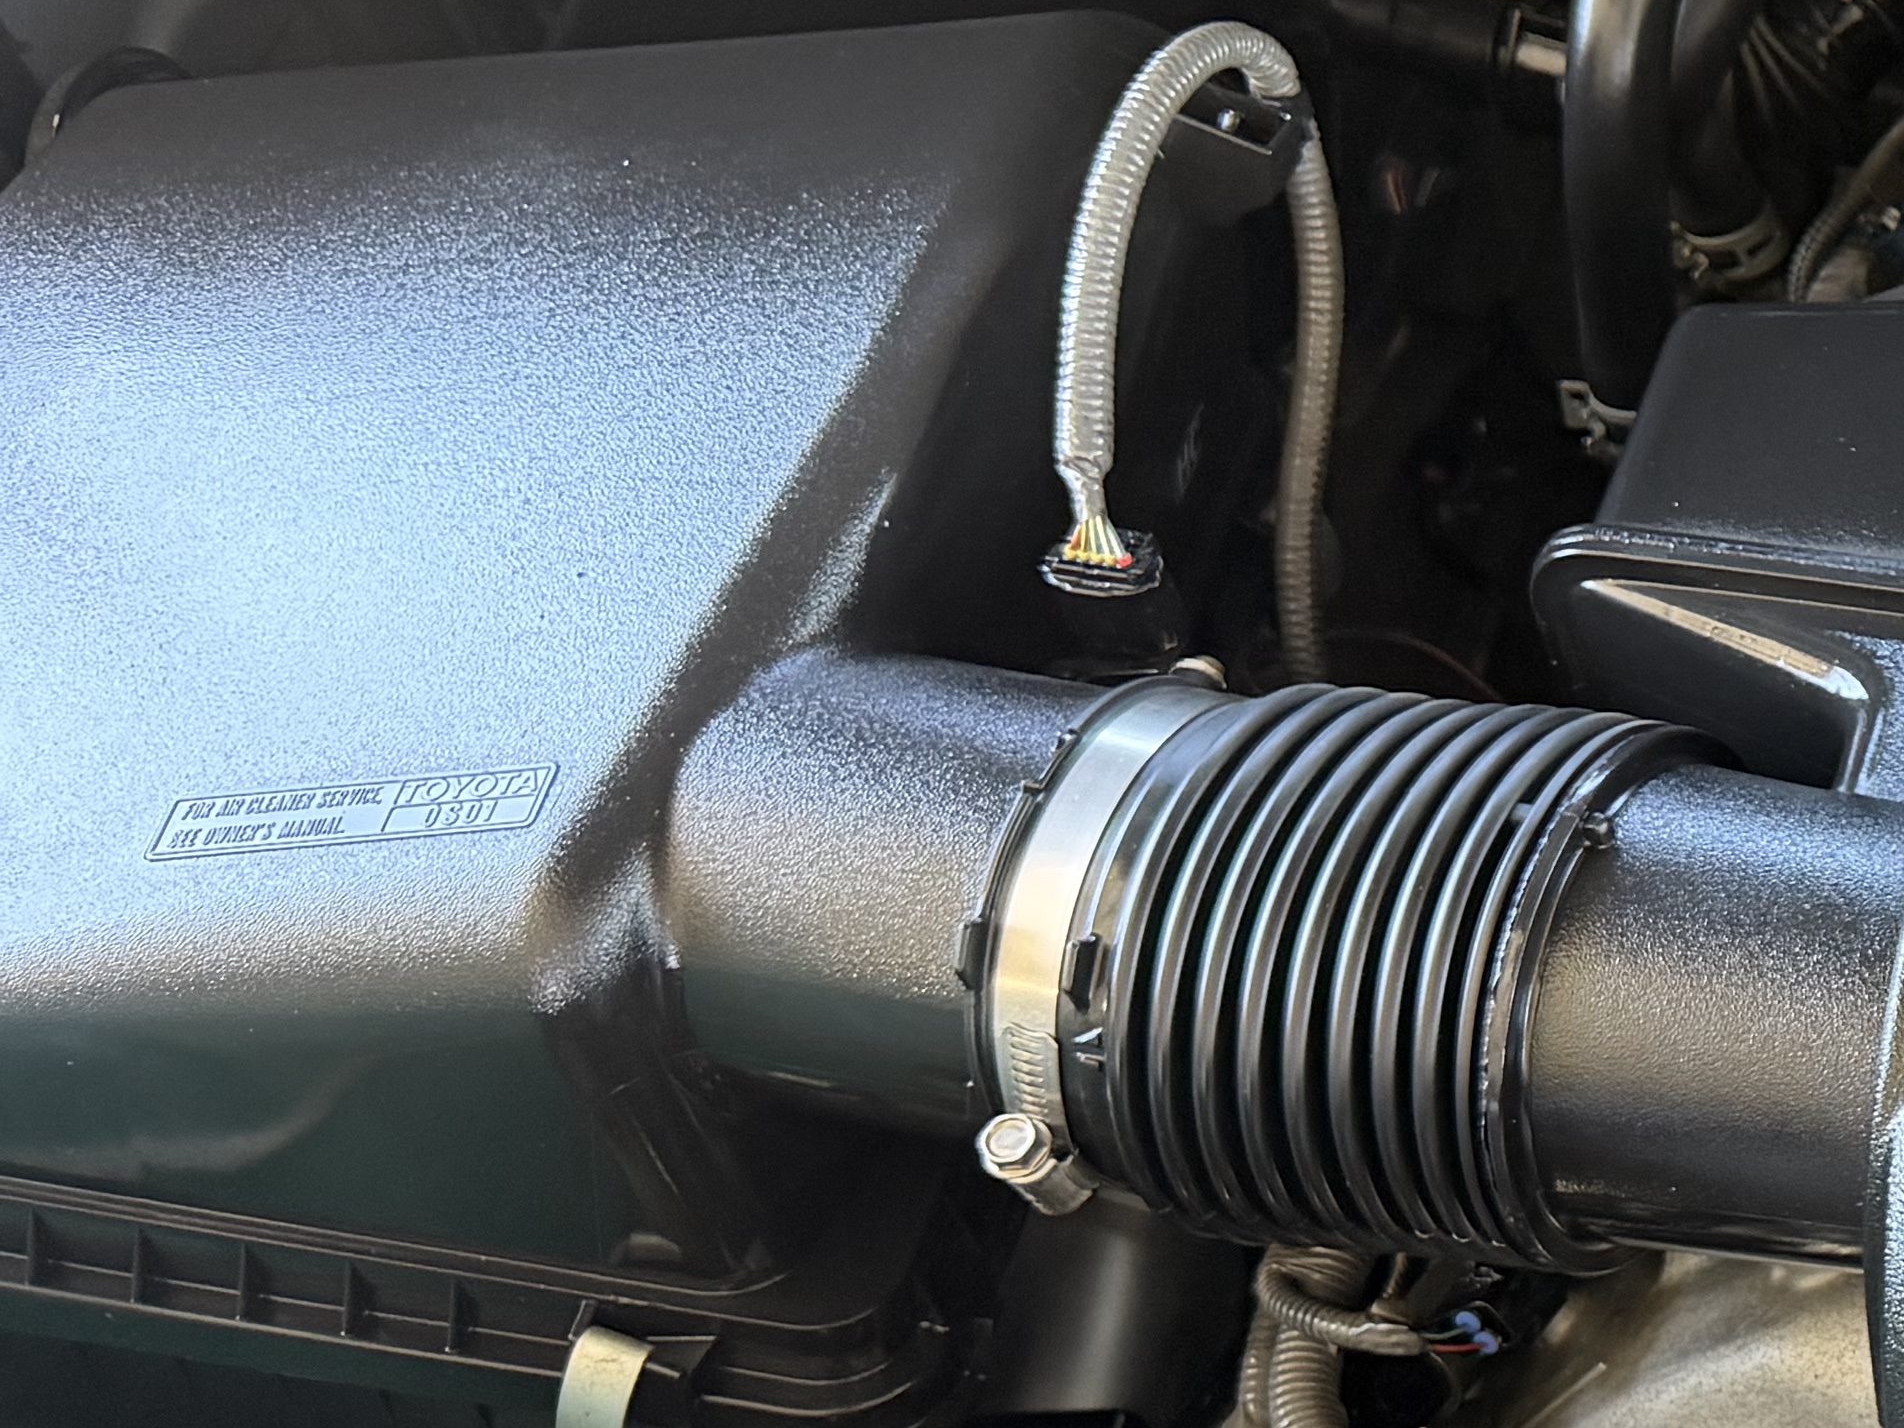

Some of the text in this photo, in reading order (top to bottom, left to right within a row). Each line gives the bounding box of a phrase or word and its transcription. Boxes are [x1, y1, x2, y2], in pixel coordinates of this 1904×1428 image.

[405, 770, 539, 803] TOYOTA
[181, 801, 216, 821] FOR
[215, 798, 246, 818] AIR
[244, 792, 317, 815] CLEANER
[168, 827, 203, 849] SEE
[203, 821, 277, 846] OWNER'S
